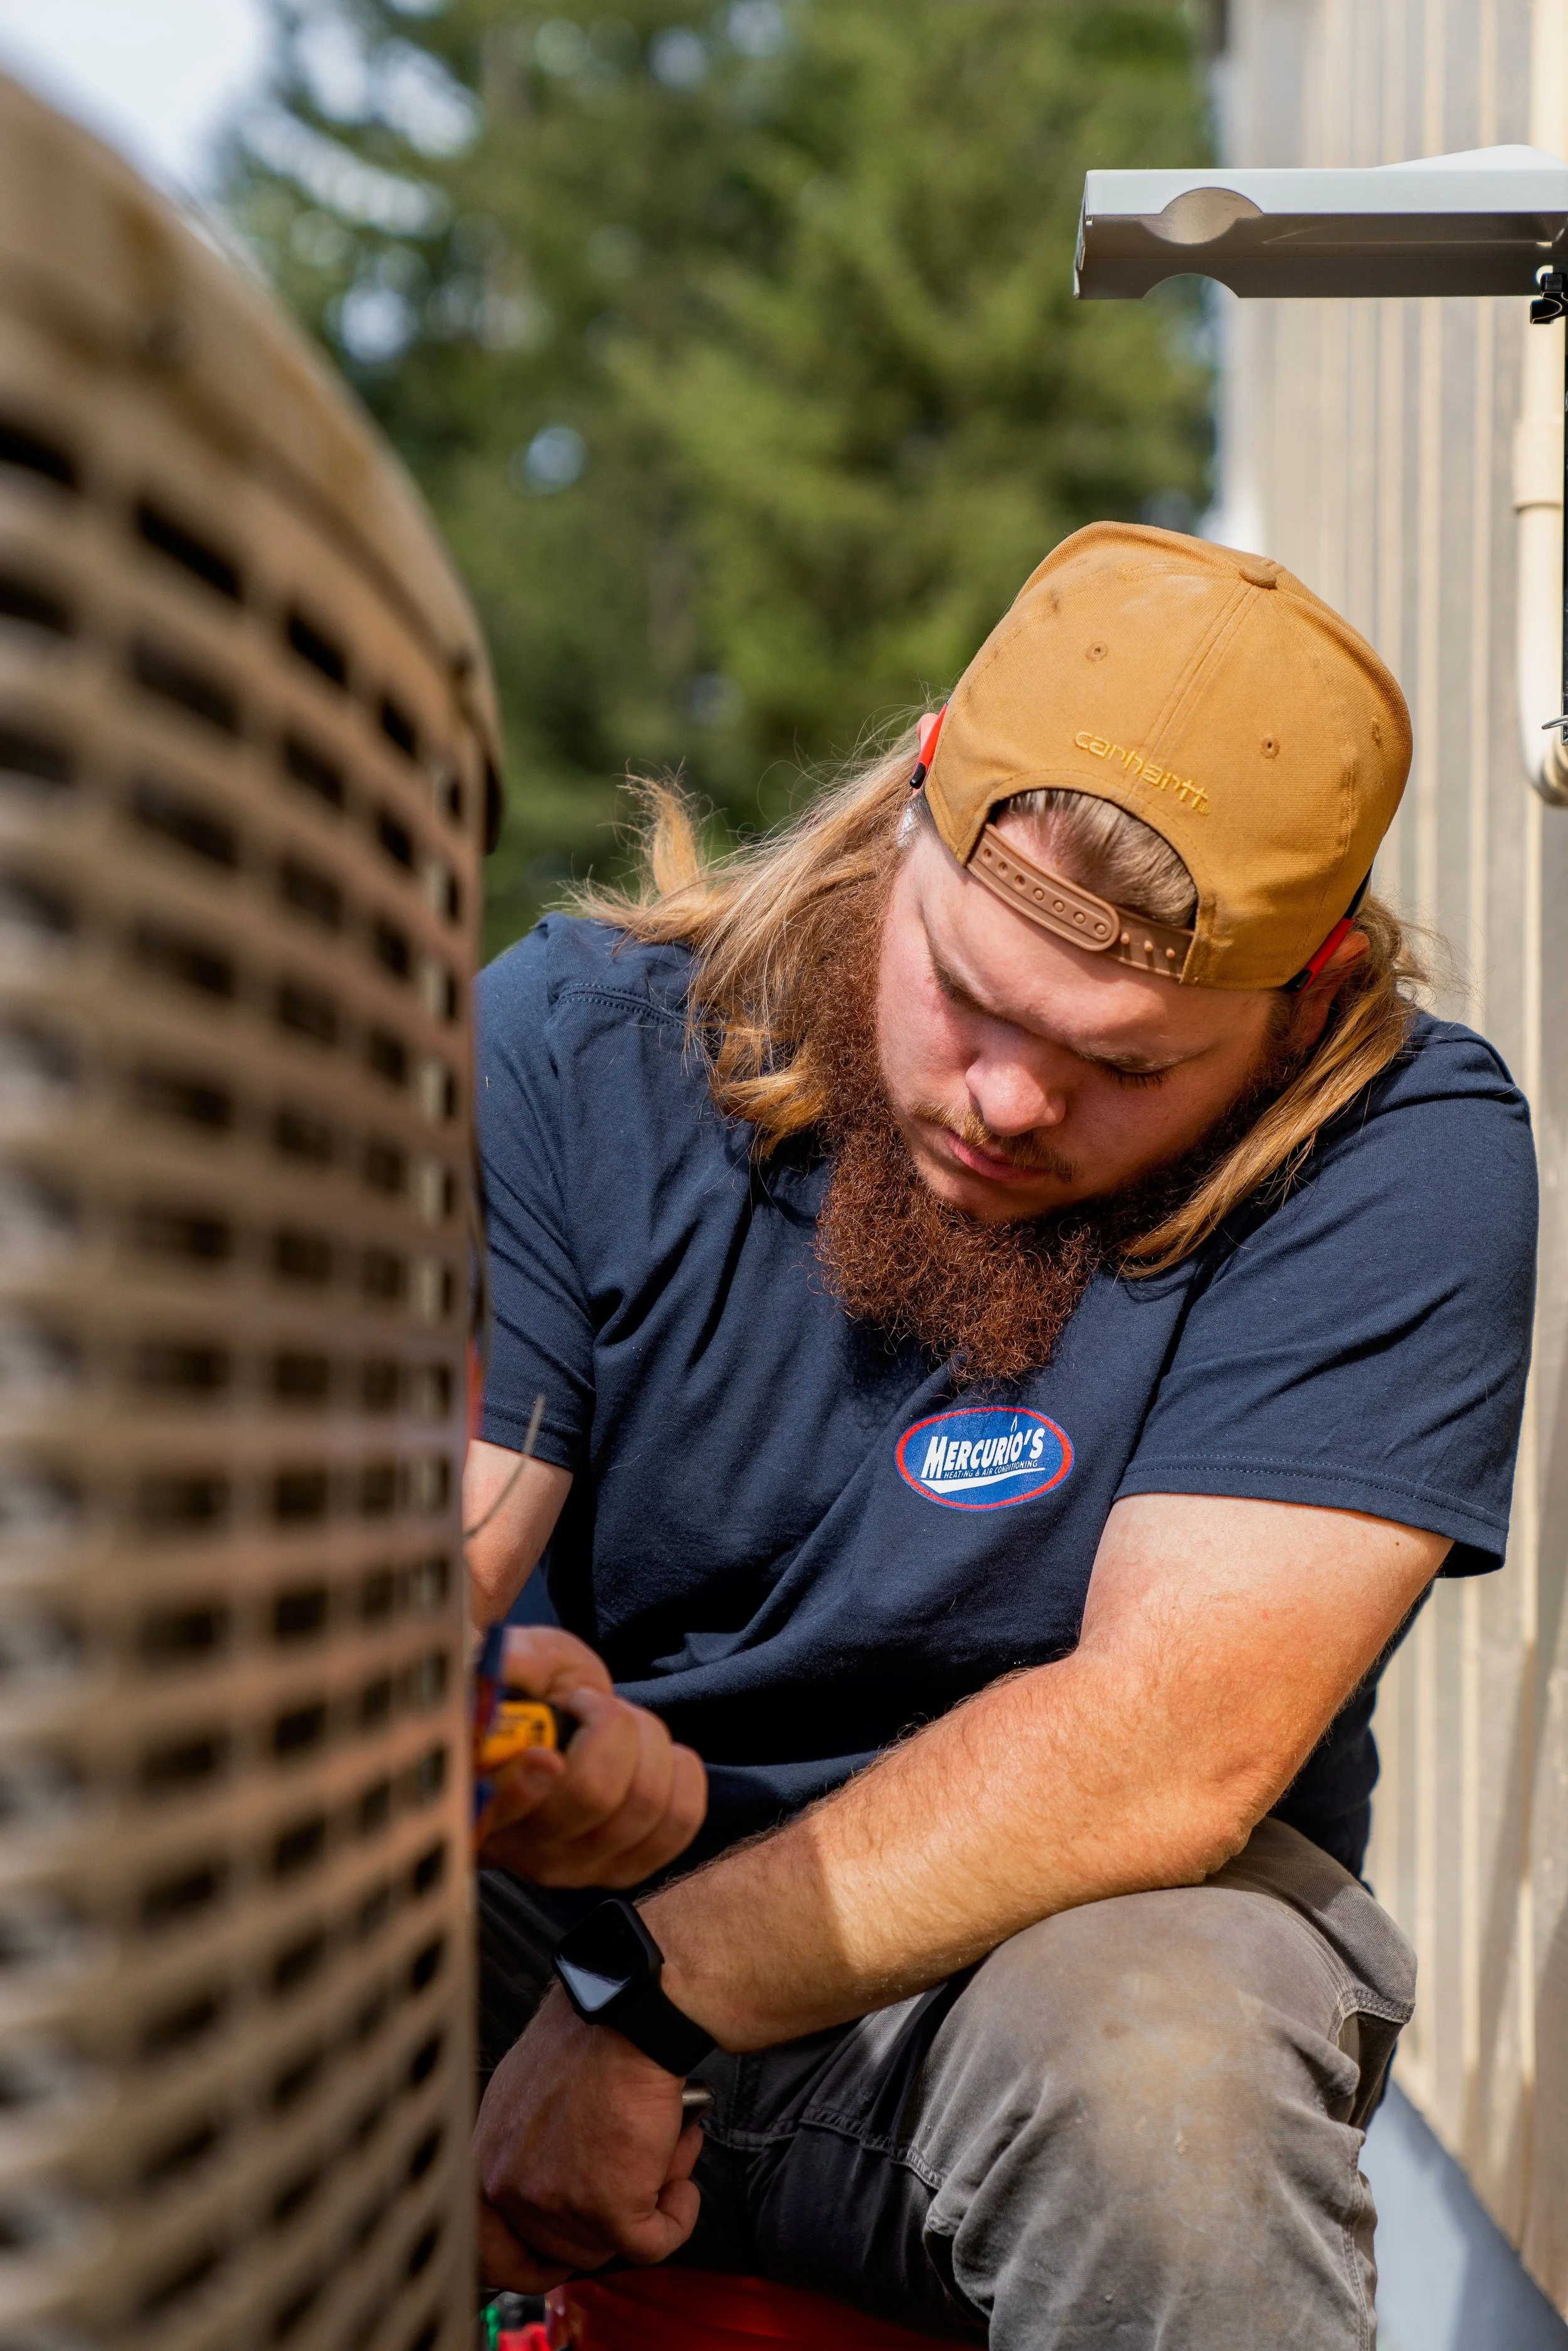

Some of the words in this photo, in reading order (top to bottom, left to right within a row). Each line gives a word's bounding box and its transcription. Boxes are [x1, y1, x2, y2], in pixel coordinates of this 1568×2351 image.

[921, 1428, 1046, 1478] MERCURIO'S
[943, 1470, 973, 1479] HEATING
[982, 1468, 993, 1476] AIR
[994, 1460, 1038, 1474] CONDITIONING
